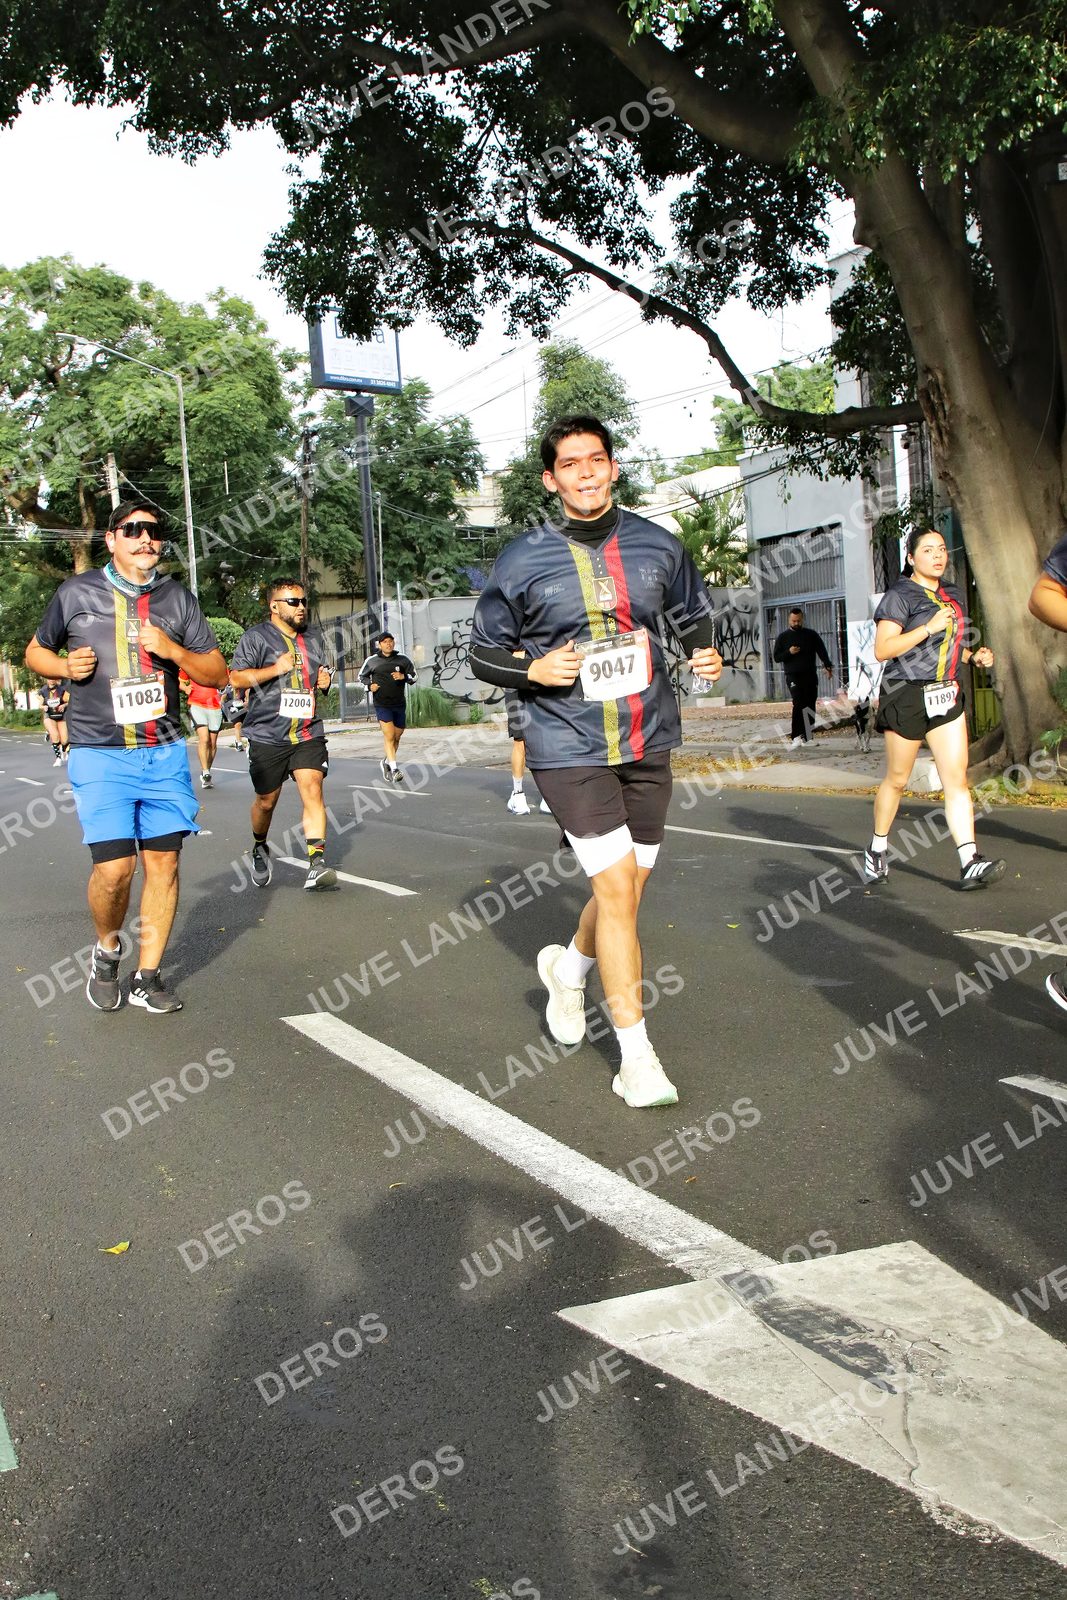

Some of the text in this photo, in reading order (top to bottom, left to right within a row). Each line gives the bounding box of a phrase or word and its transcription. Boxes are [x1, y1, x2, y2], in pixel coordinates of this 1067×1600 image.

[589, 653, 635, 682] 9047
[116, 687, 162, 708] 11082
[284, 698, 311, 708] 12004
[927, 690, 955, 706] 11891
